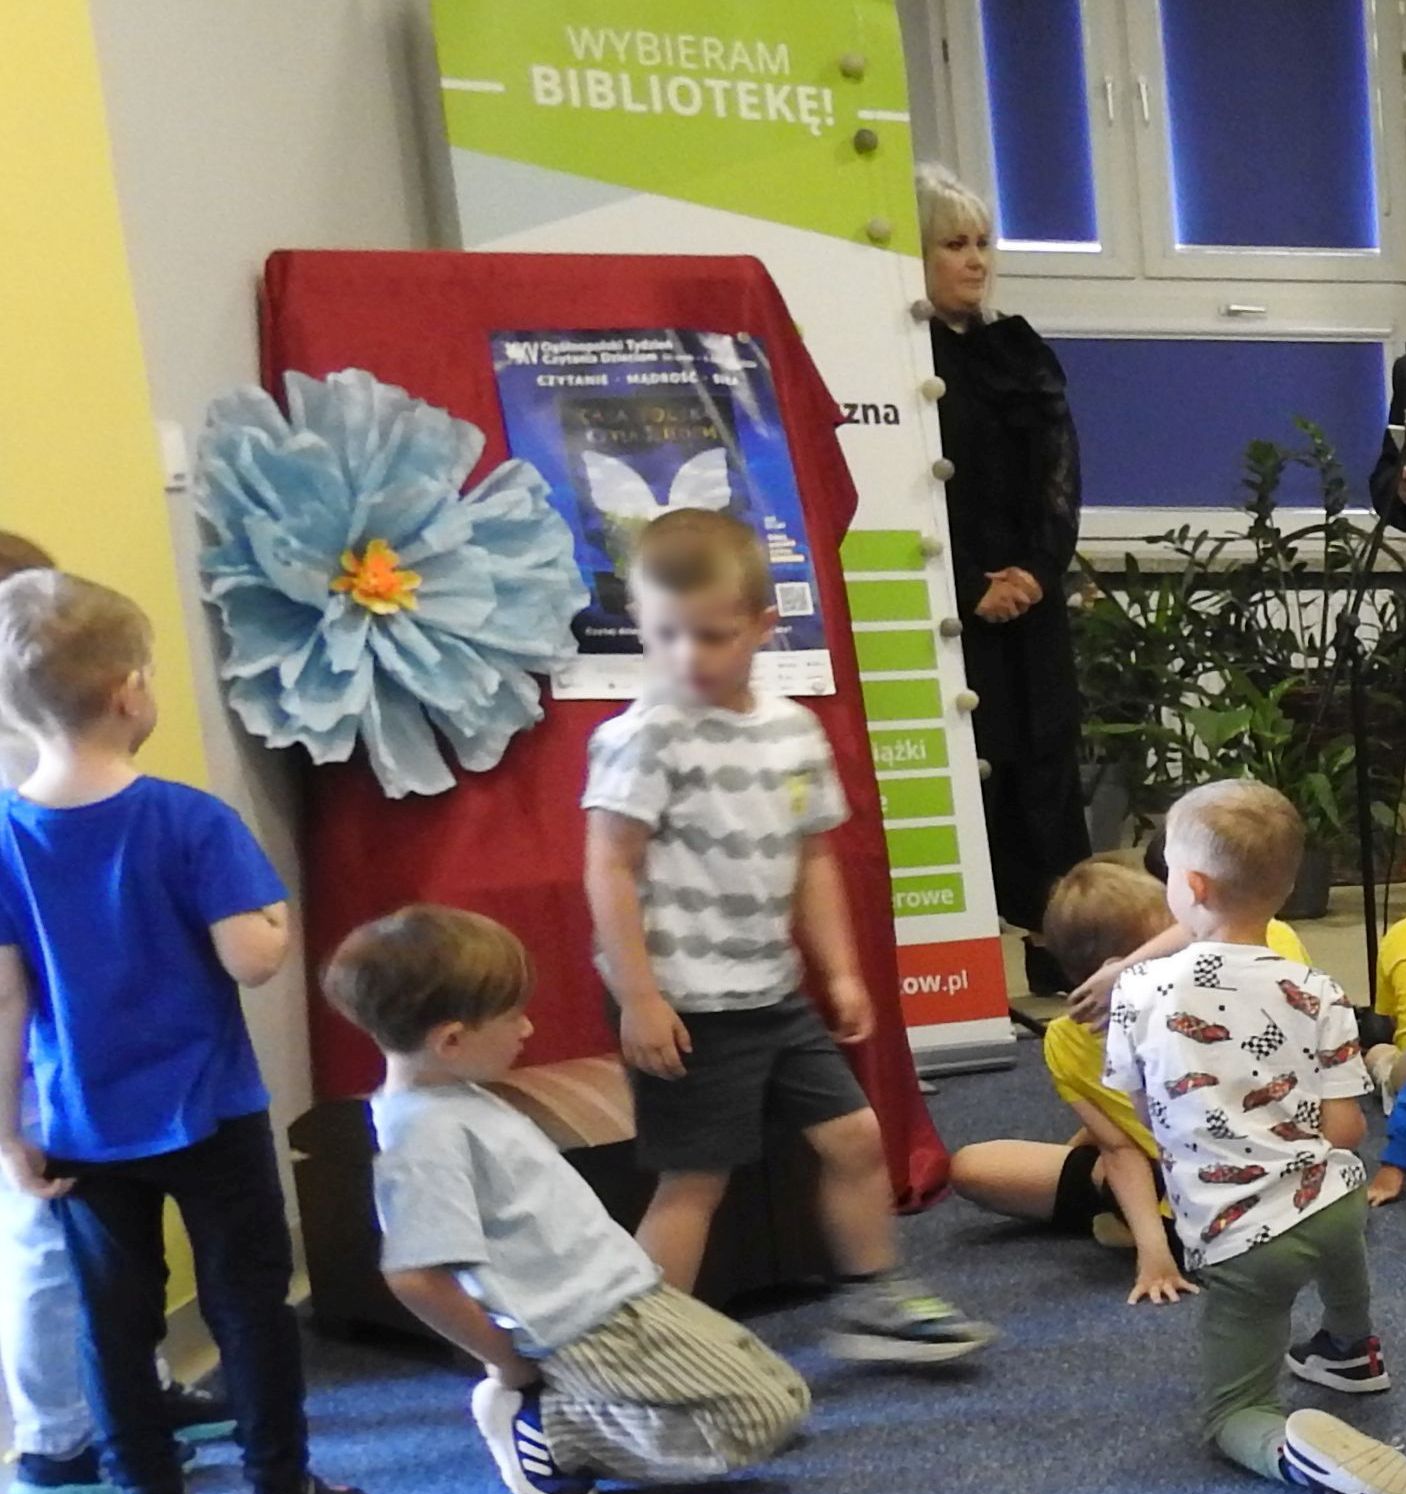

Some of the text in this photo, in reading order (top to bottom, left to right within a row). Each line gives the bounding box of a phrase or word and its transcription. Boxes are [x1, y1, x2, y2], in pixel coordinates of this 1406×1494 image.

[566, 25, 791, 75] WYBIERAM
[529, 63, 836, 136] BIBLIOTEKĘ!
[892, 888, 955, 909] rowe
[900, 969, 969, 997] ow.pl
